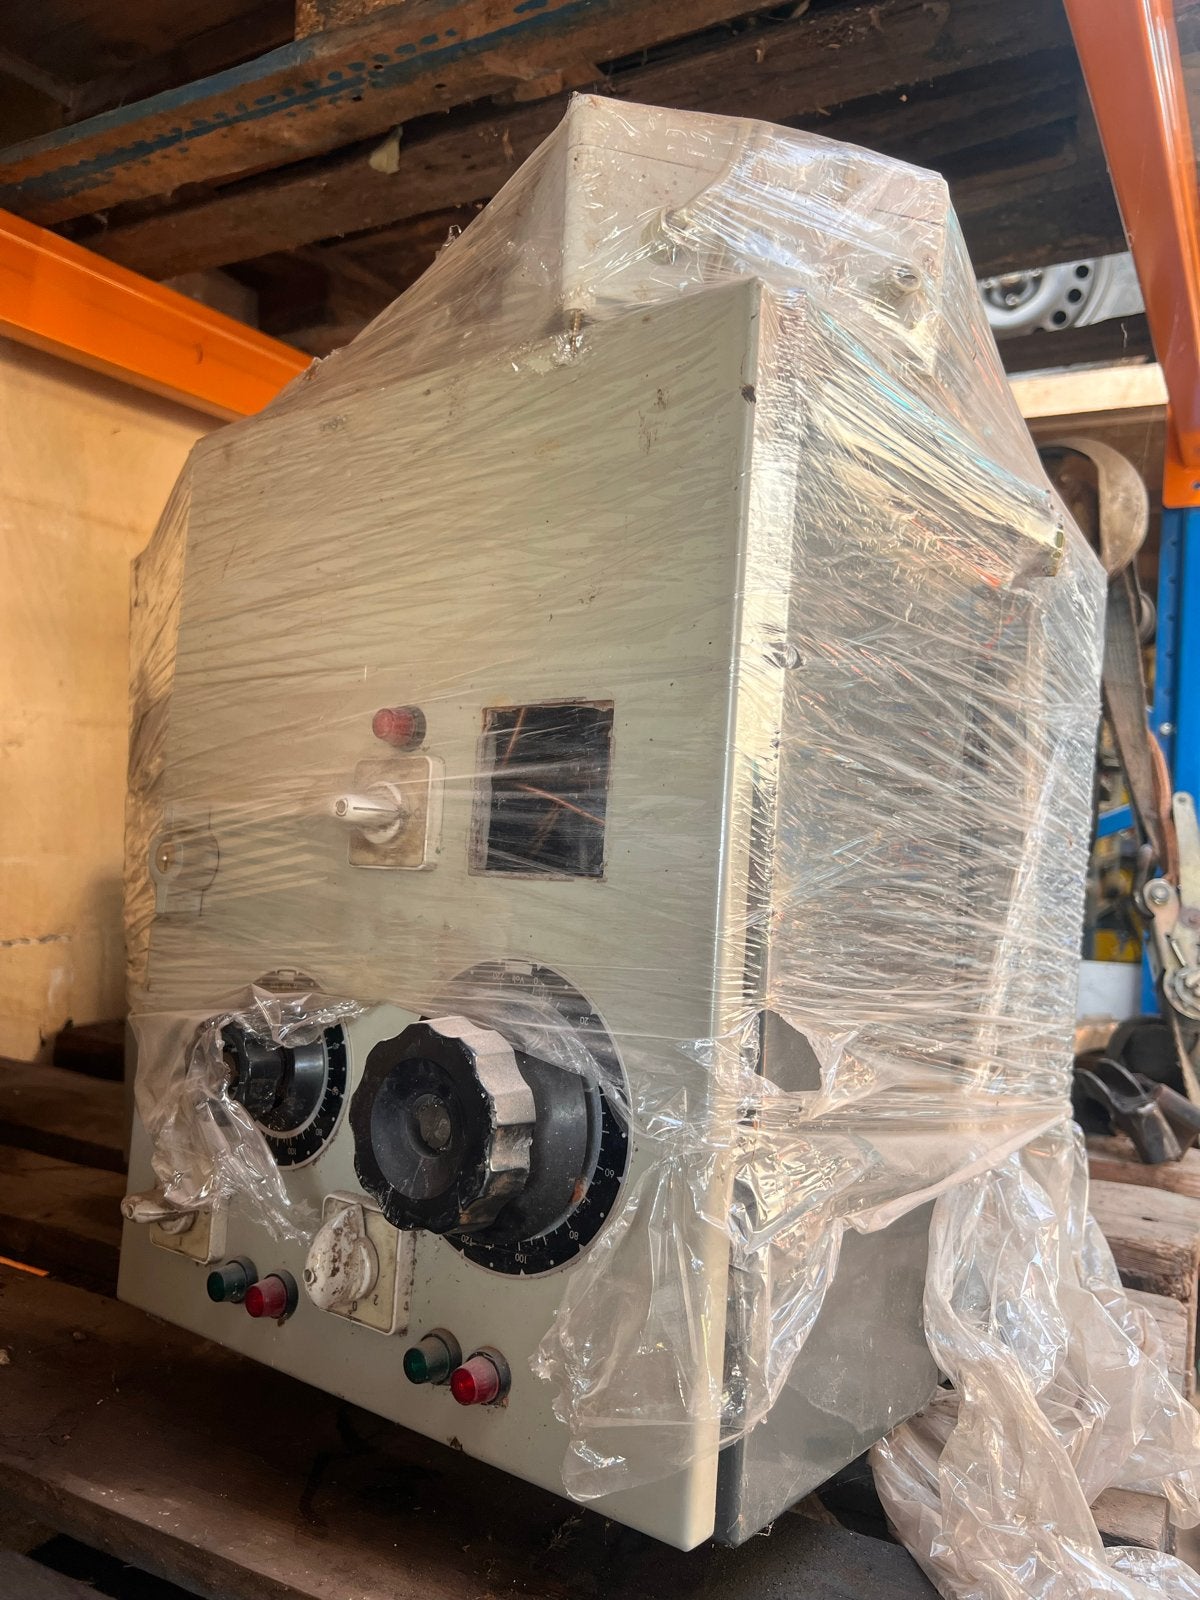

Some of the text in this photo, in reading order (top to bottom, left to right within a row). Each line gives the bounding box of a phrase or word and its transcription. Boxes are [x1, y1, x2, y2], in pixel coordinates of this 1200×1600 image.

[579, 1016, 590, 1025] 20
[604, 1169, 615, 1178] 60
[460, 1234, 473, 1246] 120
[568, 1230, 579, 1241] 80
[514, 1253, 527, 1264] 100
[352, 1294, 379, 1312] 2 0
